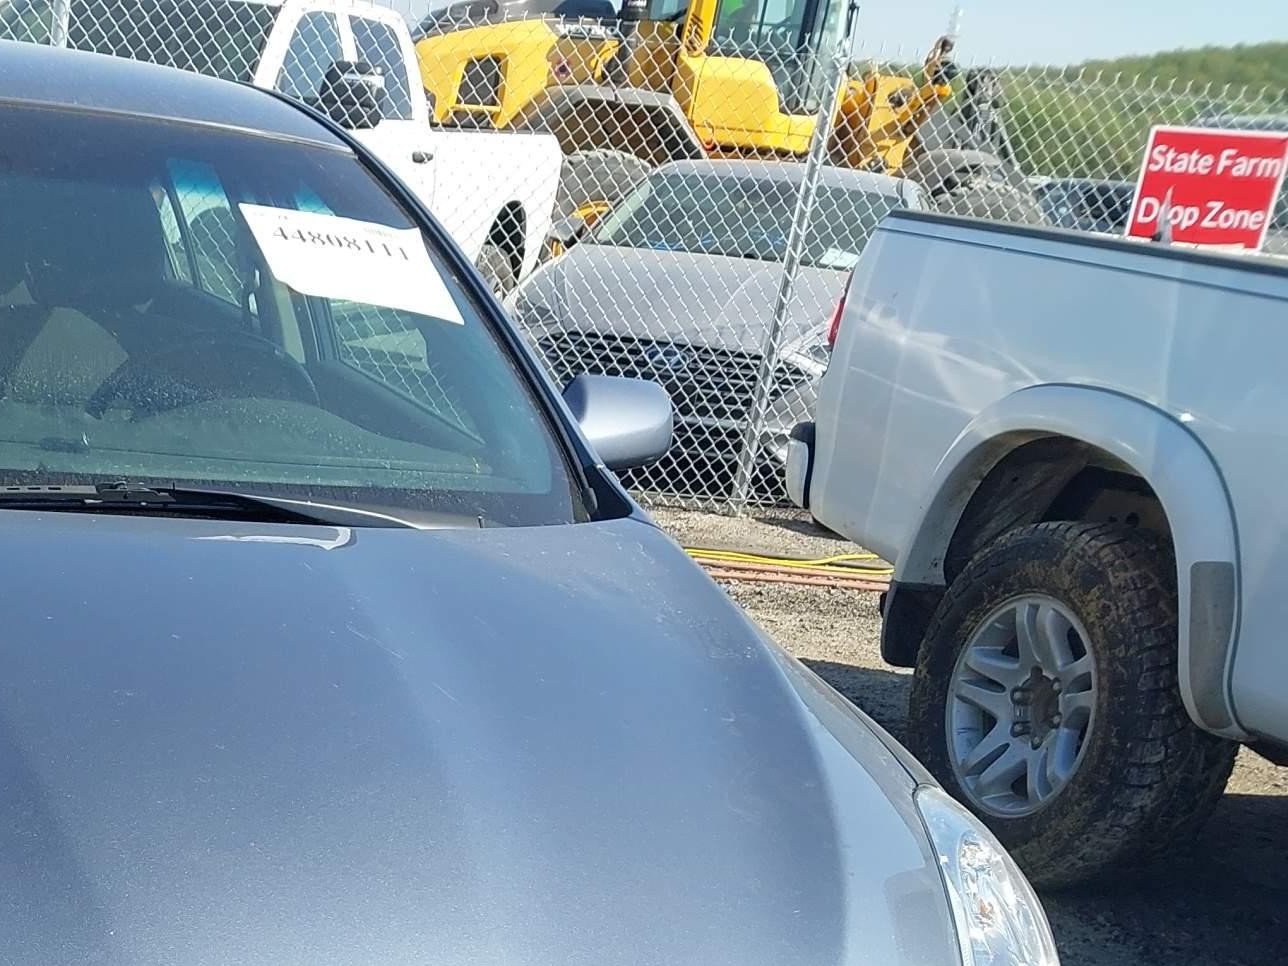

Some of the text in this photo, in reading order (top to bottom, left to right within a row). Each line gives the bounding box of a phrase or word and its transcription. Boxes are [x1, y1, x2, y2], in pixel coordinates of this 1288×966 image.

[1149, 144, 1282, 178] State Farm
[1137, 196, 1265, 230] Dop Zone
